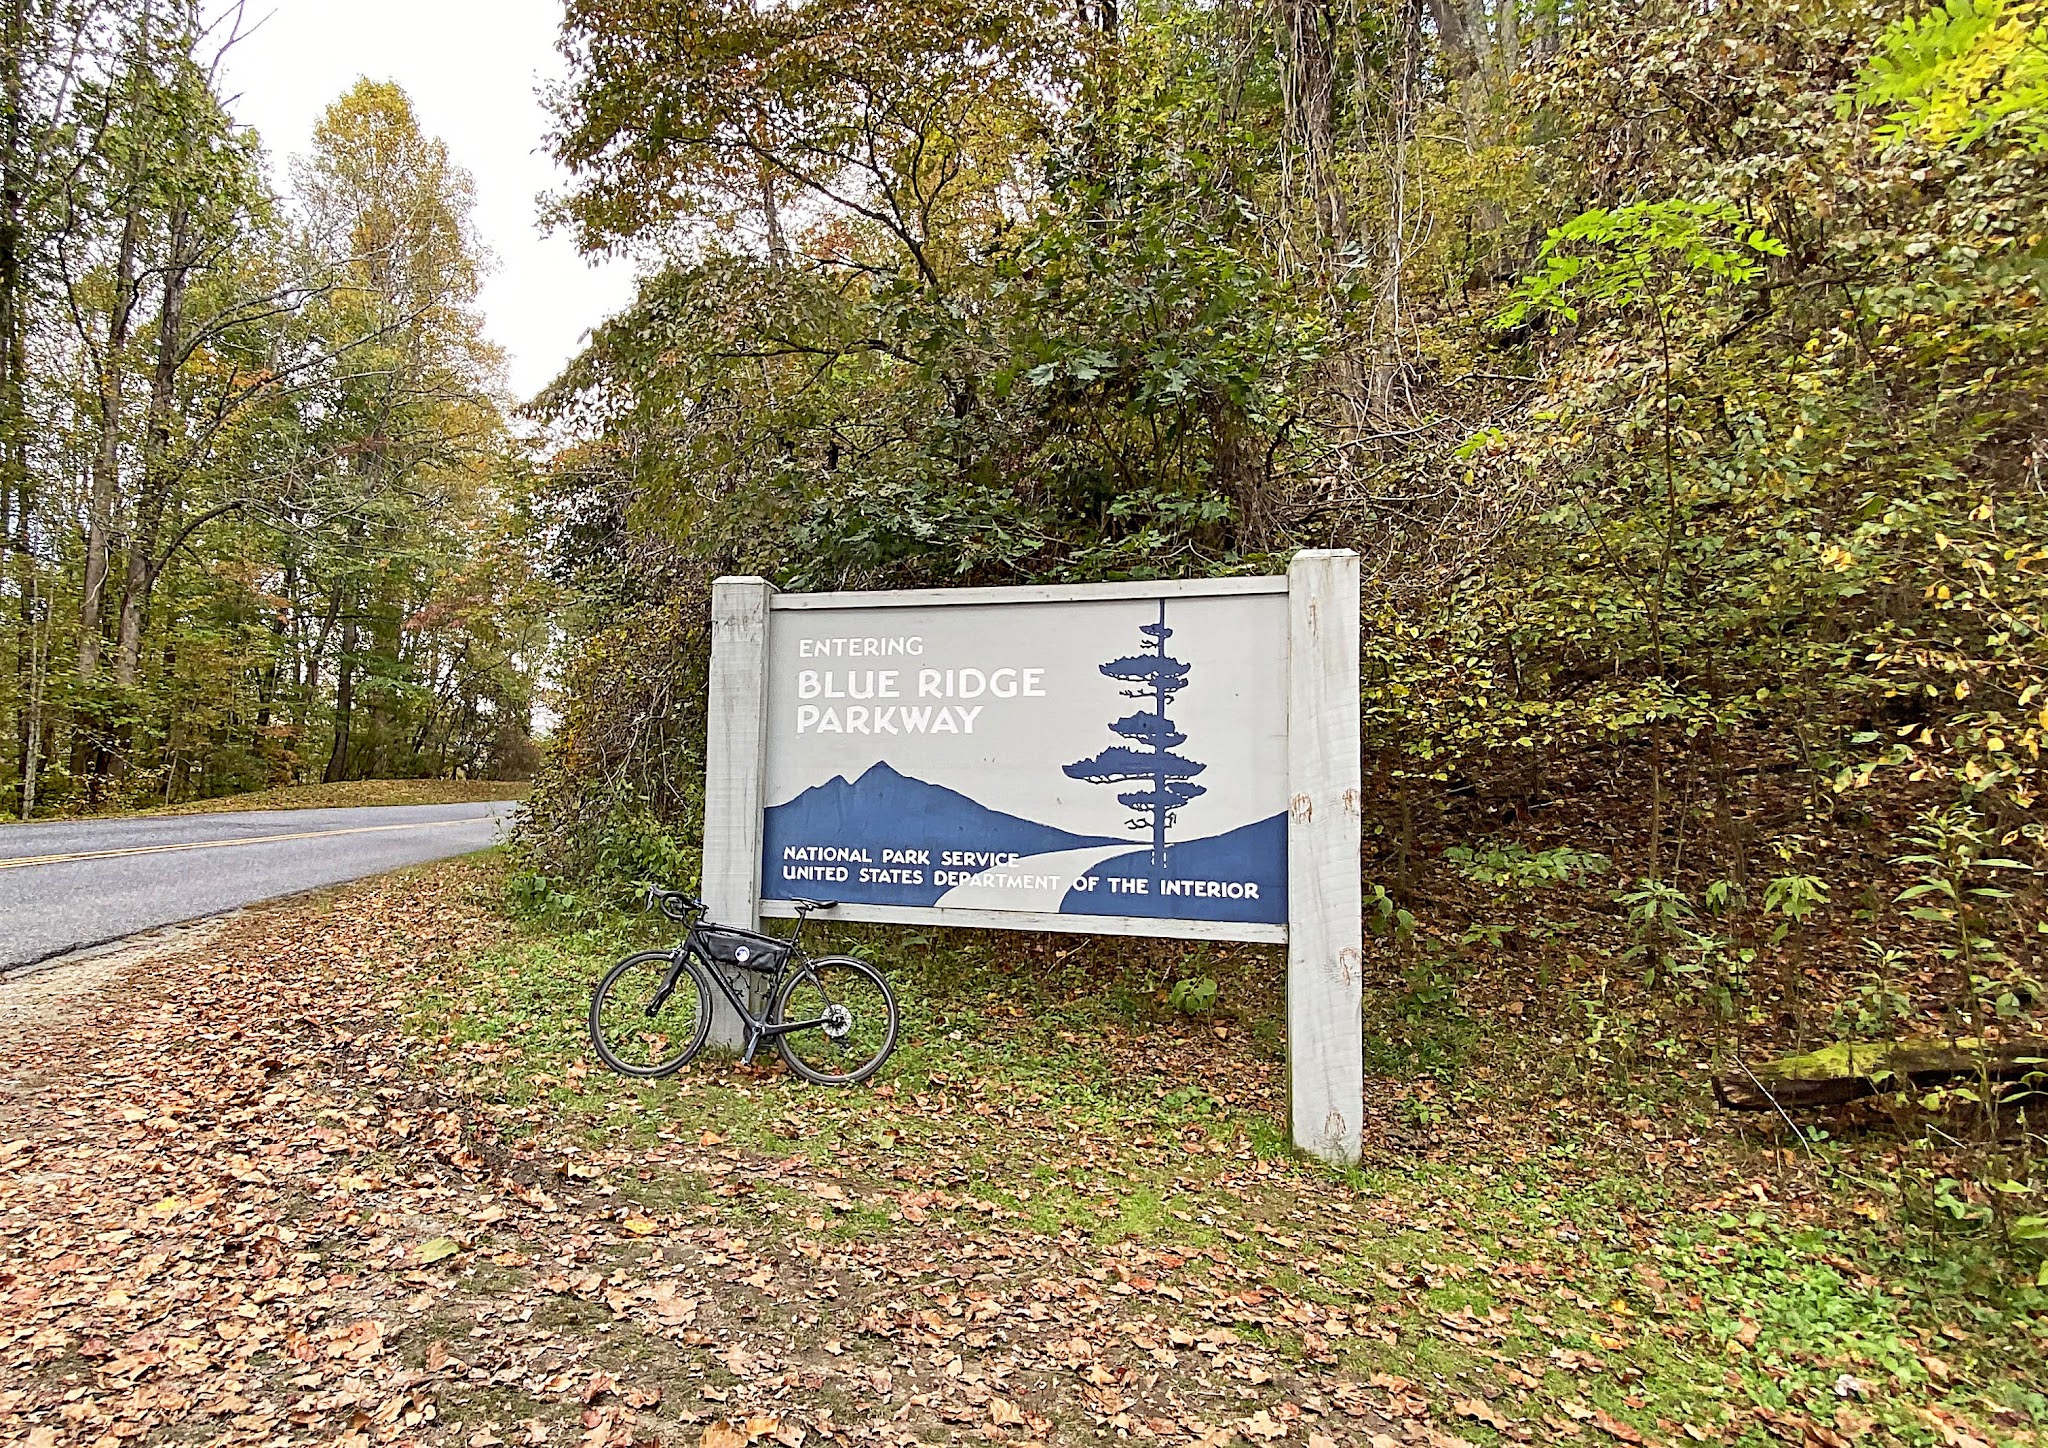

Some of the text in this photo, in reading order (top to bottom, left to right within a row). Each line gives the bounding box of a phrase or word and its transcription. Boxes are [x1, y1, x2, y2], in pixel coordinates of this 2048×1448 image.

[799, 636, 924, 657] ENTERING
[798, 668, 1047, 699] BLUE RIDGE
[797, 704, 984, 735] PARKWAY
[783, 846, 1020, 868] NATIONAL PARK SERVICE
[782, 866, 1260, 899] UNITED STATES DEPARTMENT OF THE INTERIOR
